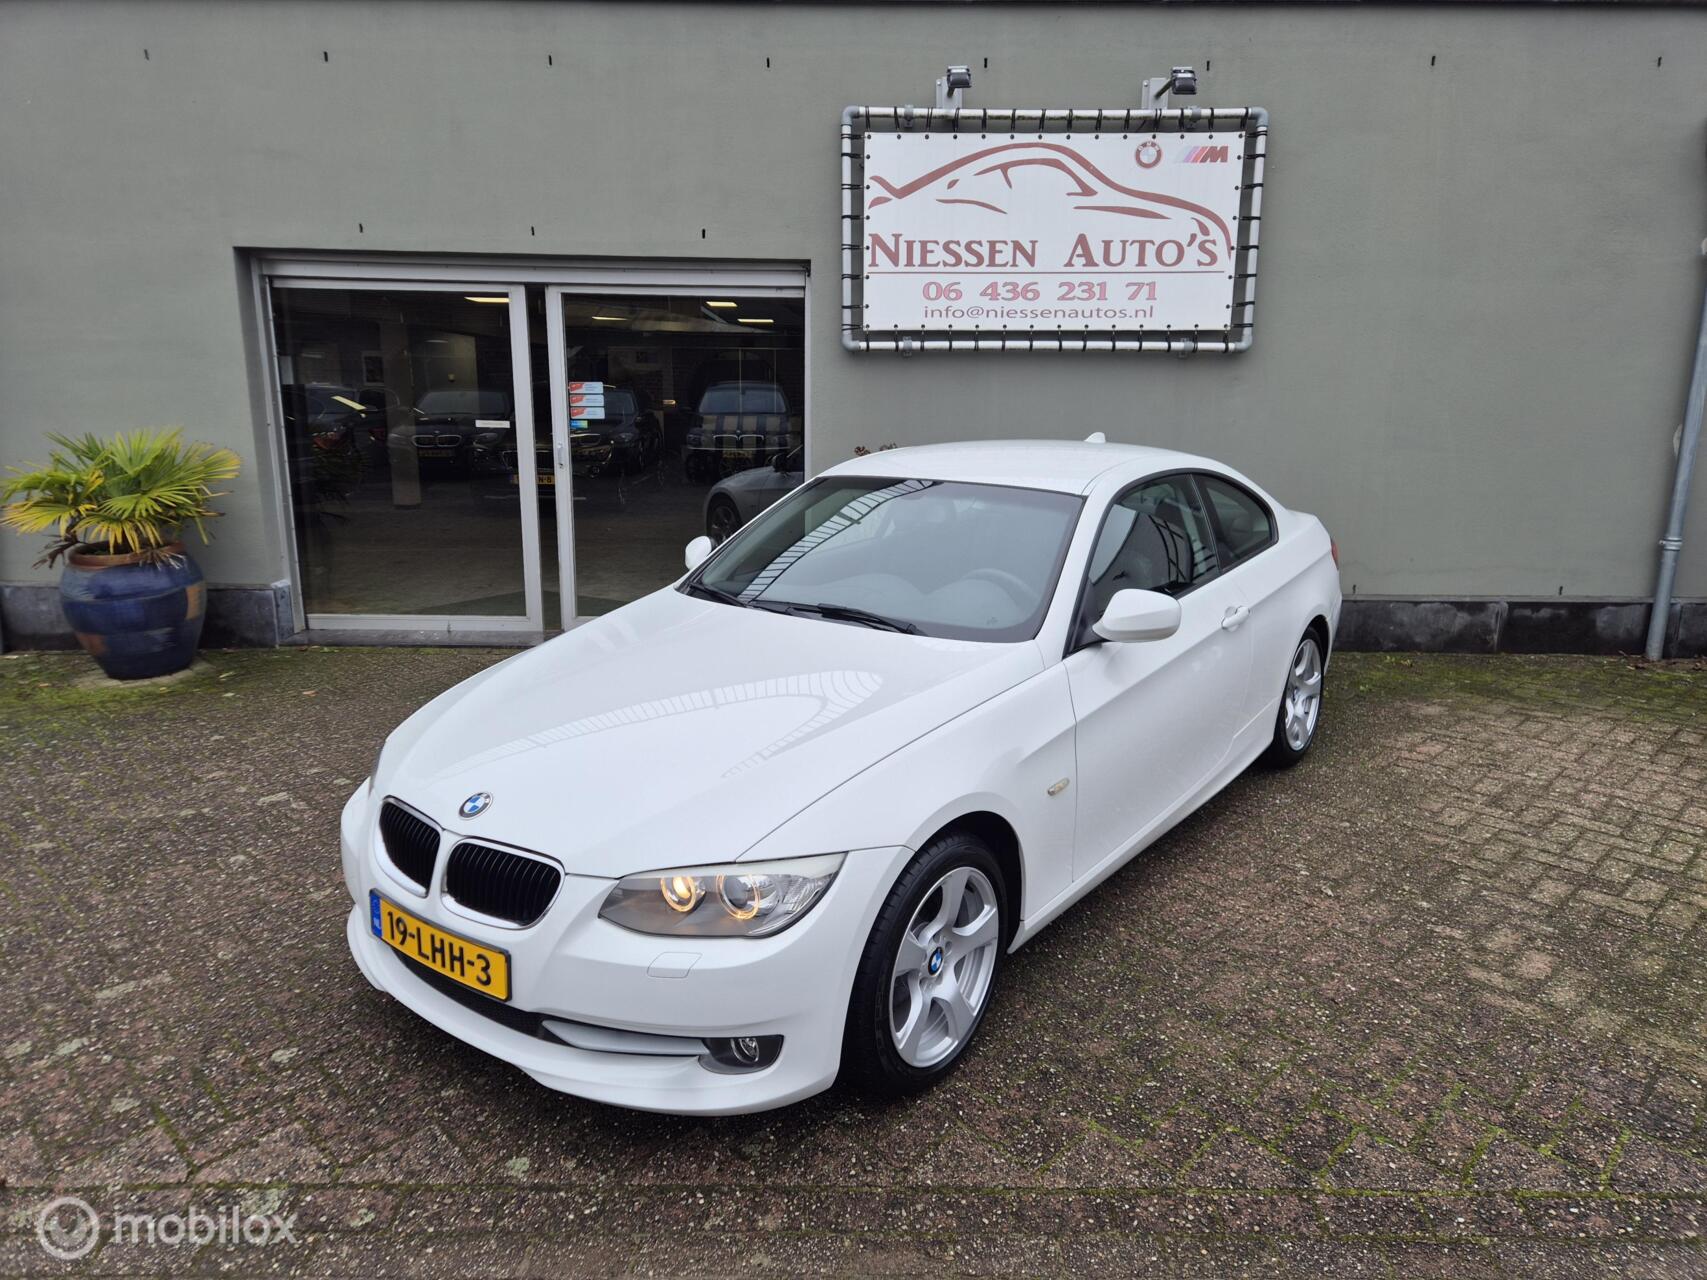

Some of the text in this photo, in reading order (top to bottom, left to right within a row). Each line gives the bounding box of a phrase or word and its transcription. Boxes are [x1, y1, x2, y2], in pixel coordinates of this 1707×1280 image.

[868, 233, 1218, 268] NIESSEN AUTO'S
[922, 281, 1157, 301] 06 436 231 71
[924, 305, 1154, 319] info@niessenautos.nl
[388, 912, 492, 986] 19-LHH-3
